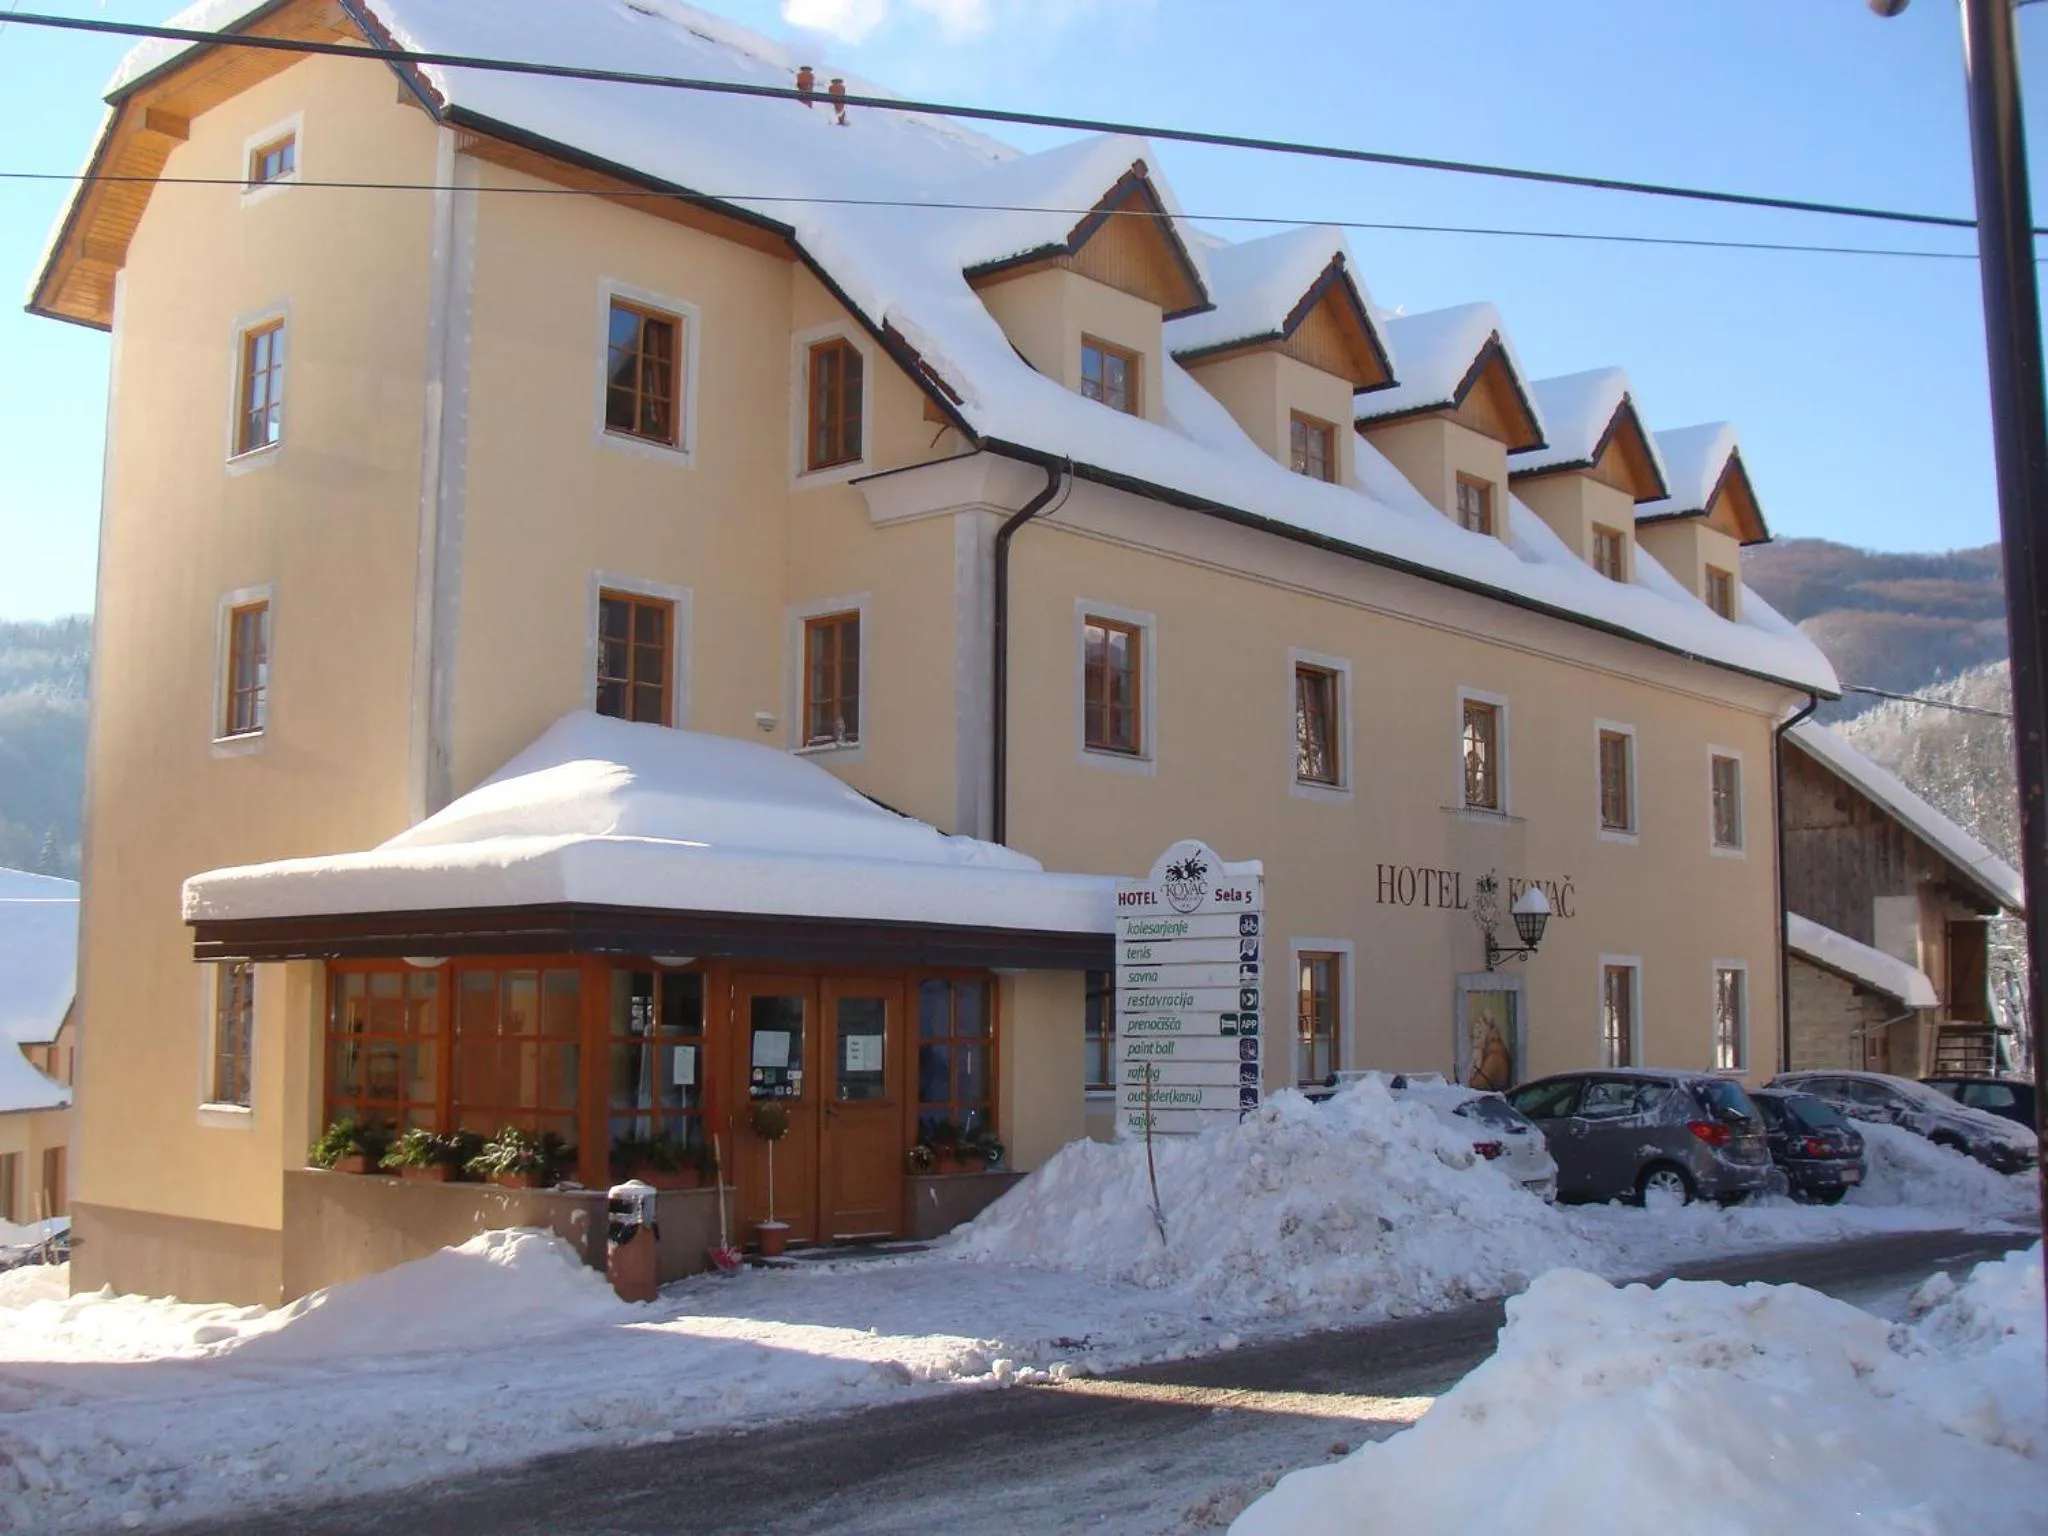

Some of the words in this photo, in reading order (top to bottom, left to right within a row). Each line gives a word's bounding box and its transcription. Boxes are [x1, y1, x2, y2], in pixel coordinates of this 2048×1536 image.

[1376, 863, 1469, 910] HOTEL
[1118, 891, 1159, 906] HOTEL
[1214, 888, 1242, 902] Sela
[1245, 891, 1252, 904] 5
[1127, 919, 1189, 936] kolesarjenje
[1127, 946, 1152, 960] tenis
[1128, 971, 1158, 983] savna
[1127, 991, 1194, 1009] restavracija
[1128, 1041, 1153, 1056] paint
[1155, 1041, 1175, 1055] ball
